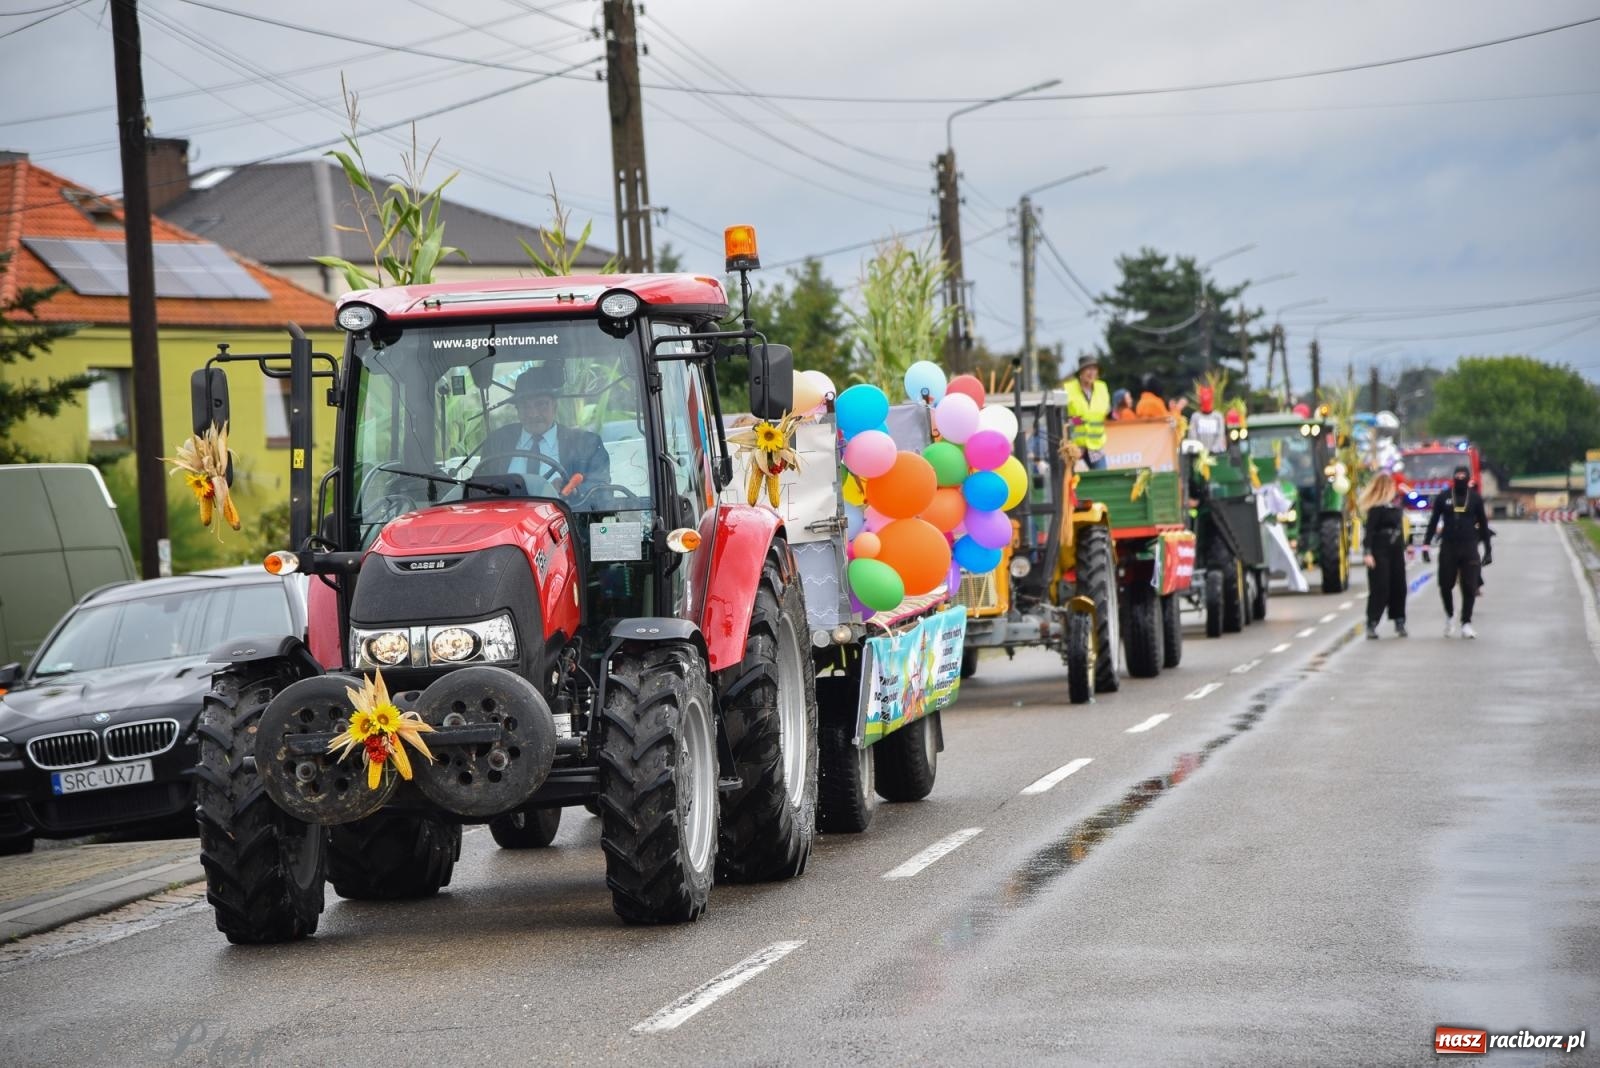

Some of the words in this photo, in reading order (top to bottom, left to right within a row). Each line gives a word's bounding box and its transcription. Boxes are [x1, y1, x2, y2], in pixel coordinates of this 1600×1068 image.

[433, 335, 558, 350] www.agrocentrum.net
[64, 771, 98, 791] SRC
[104, 762, 146, 784] UX77
